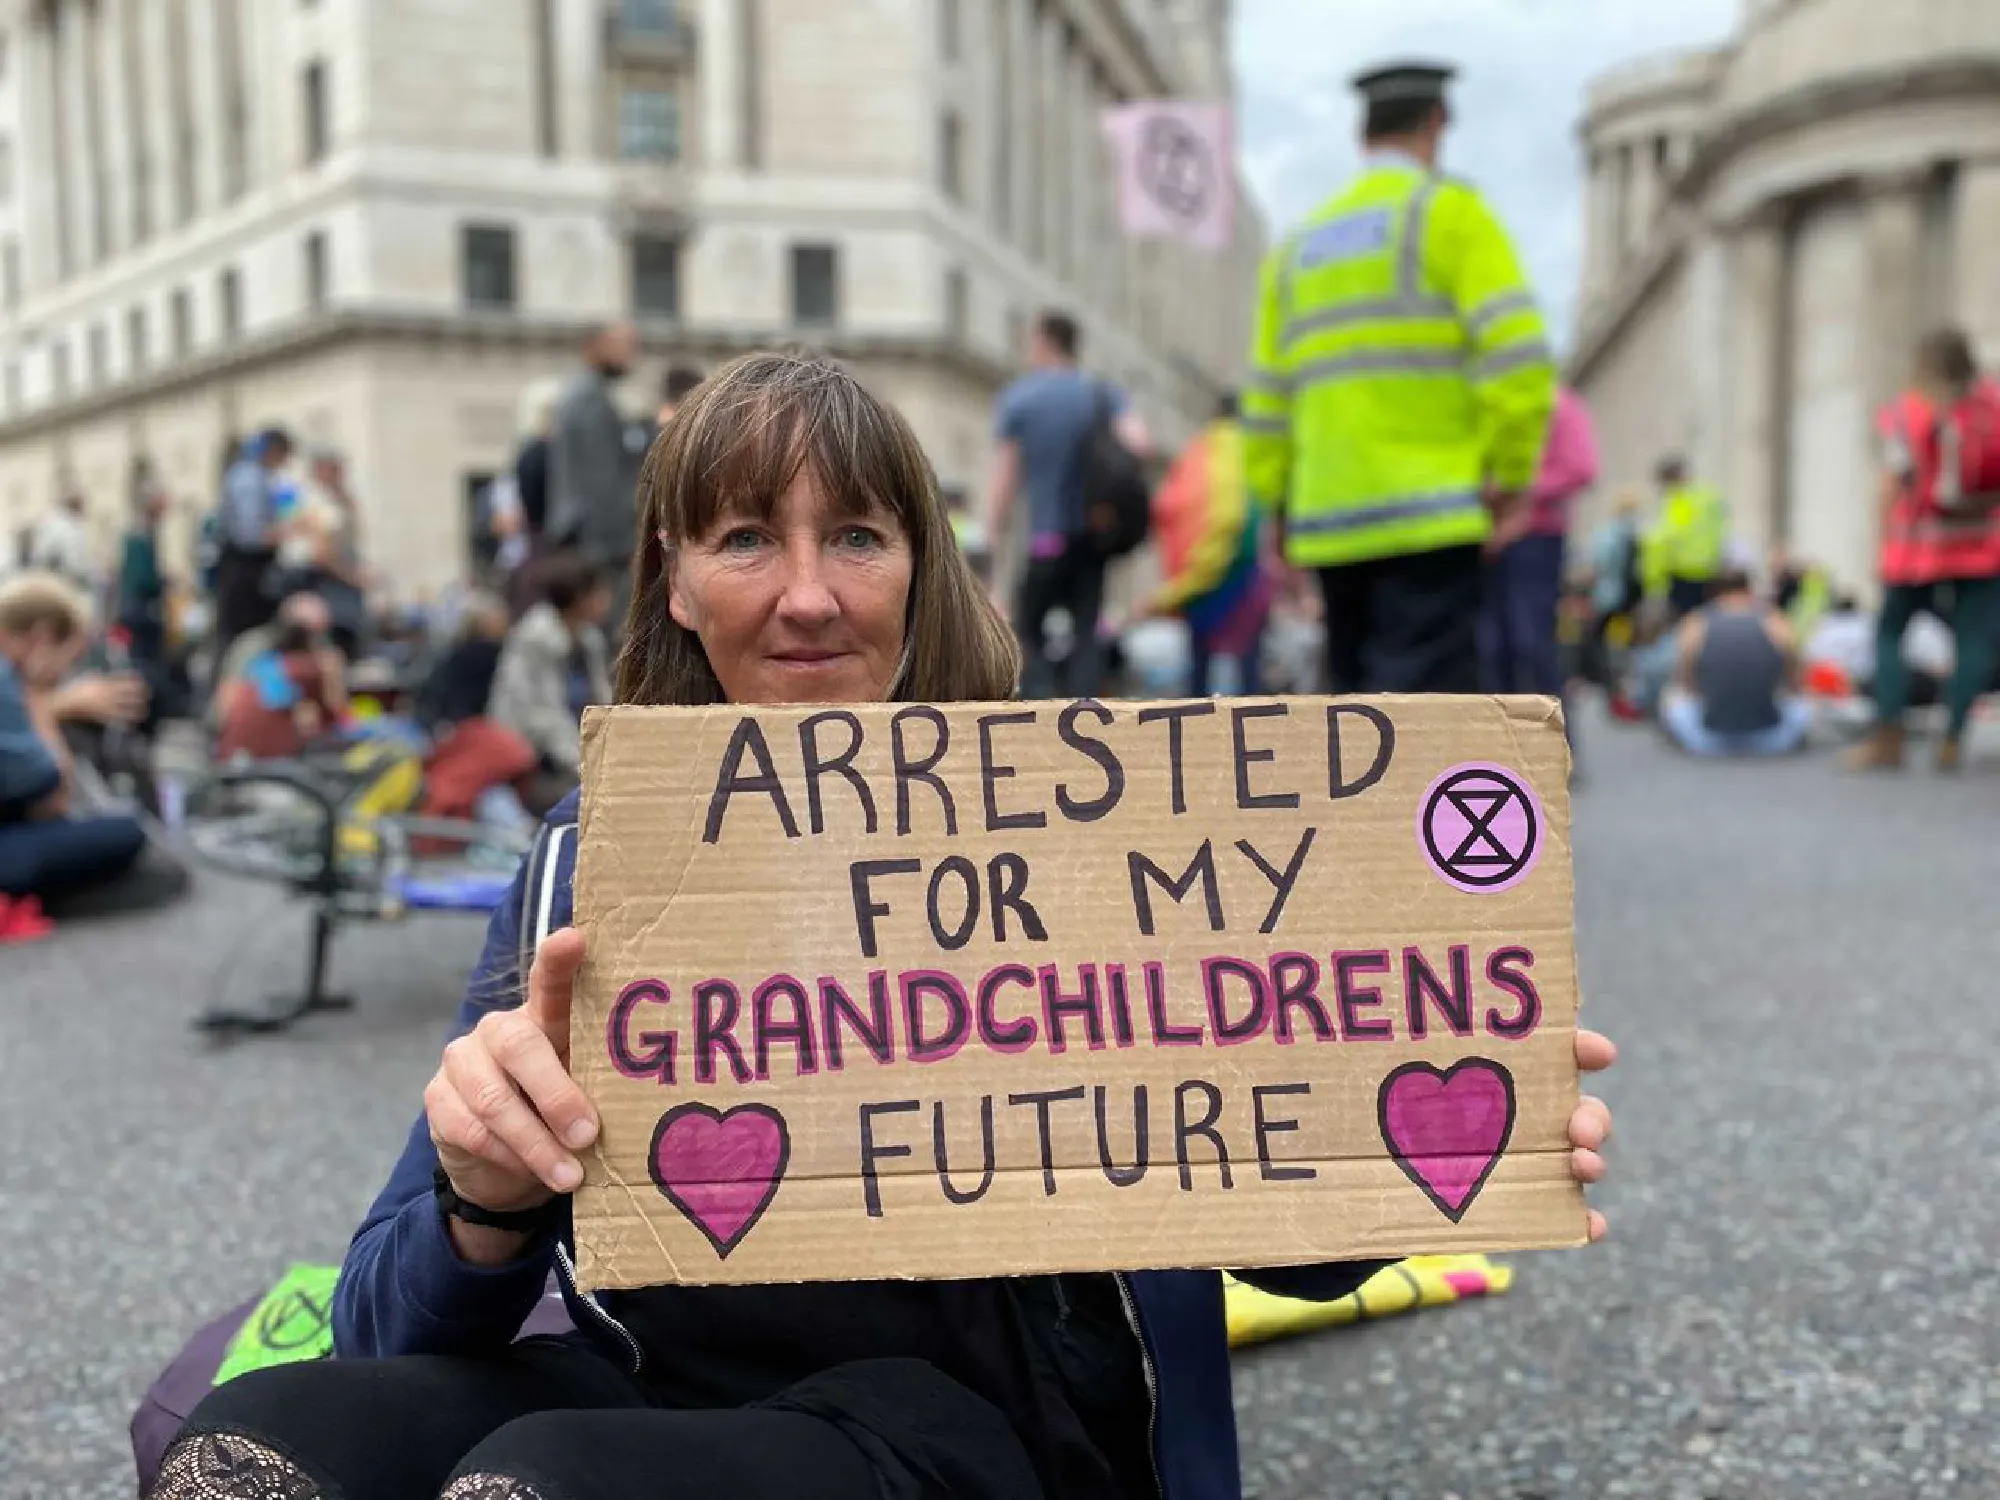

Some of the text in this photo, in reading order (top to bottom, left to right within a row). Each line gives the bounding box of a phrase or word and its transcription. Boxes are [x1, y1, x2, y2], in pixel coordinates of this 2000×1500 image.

[702, 698, 1396, 845] ARRESTED
[850, 827, 1316, 958] FOR MY
[607, 943, 1542, 1085] GRANDCHILDRENS
[860, 1080, 1317, 1219] FUTURE
